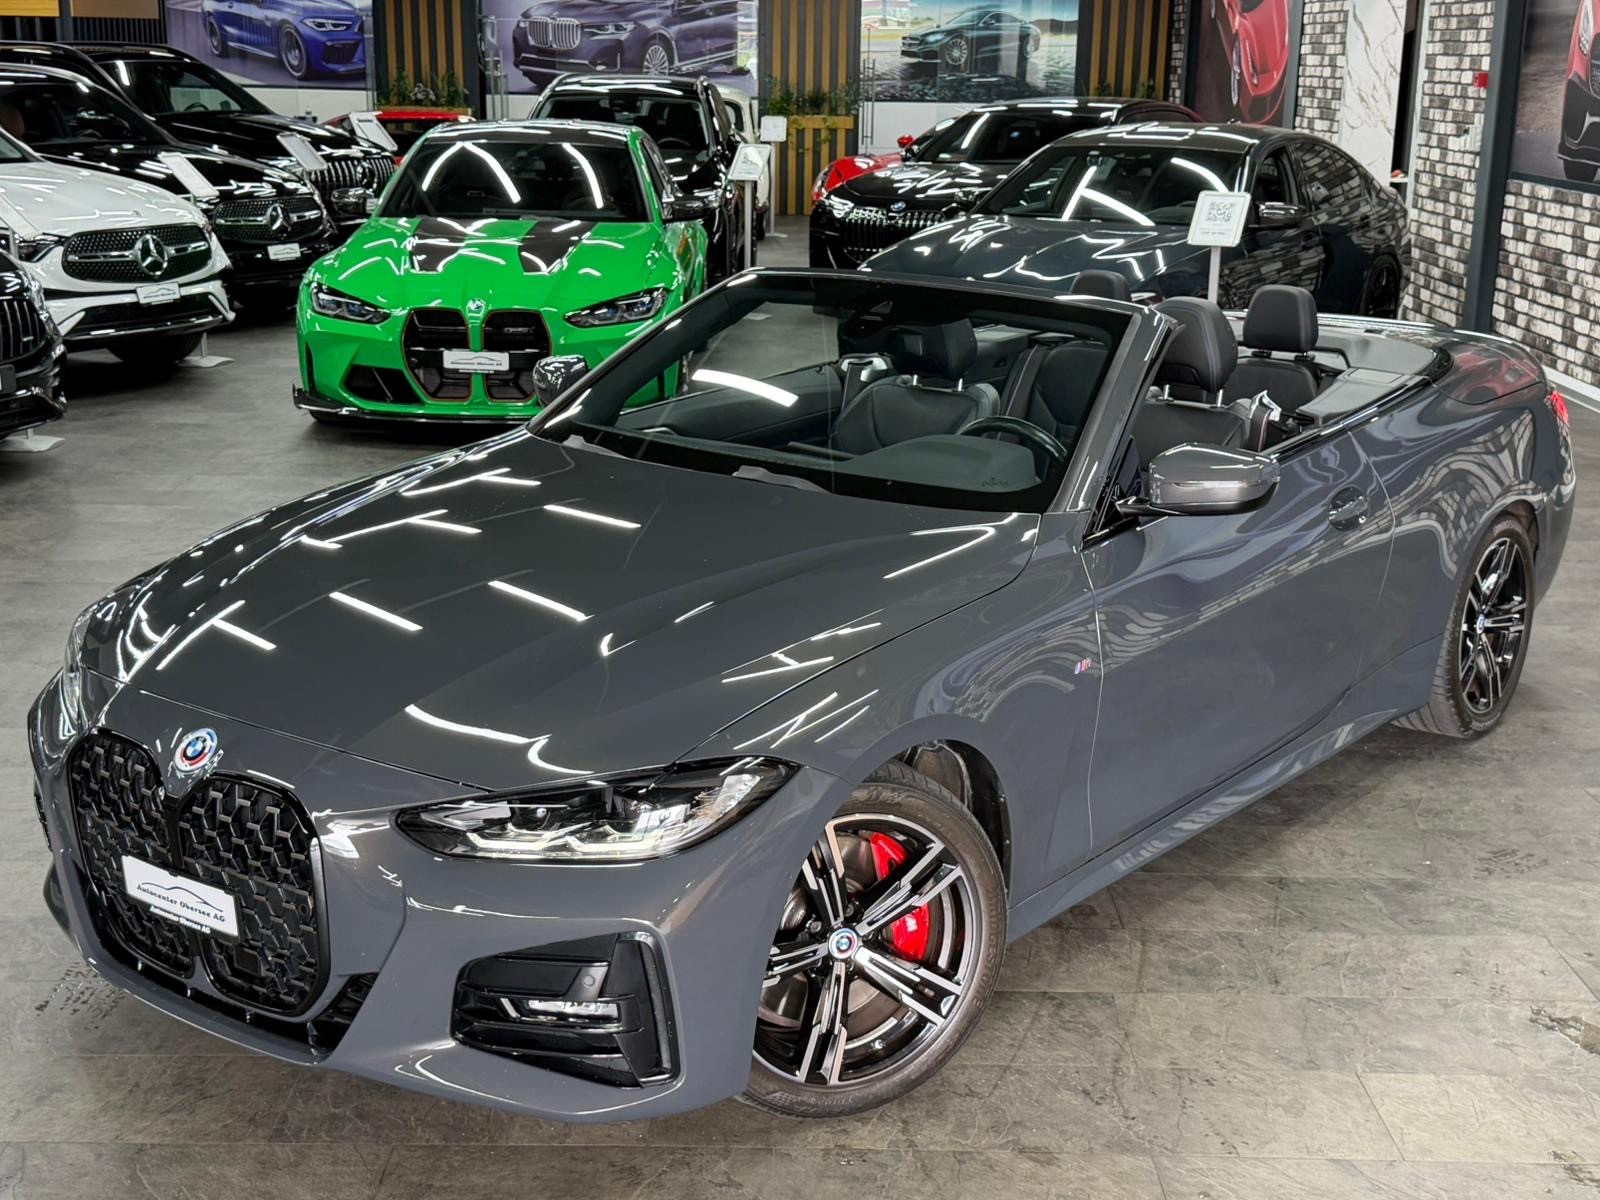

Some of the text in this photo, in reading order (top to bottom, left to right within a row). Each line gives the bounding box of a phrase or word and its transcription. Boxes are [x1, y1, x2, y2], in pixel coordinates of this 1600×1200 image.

[136, 884, 225, 922] Autocenter Obersee AG
[201, 925, 211, 934] AG
